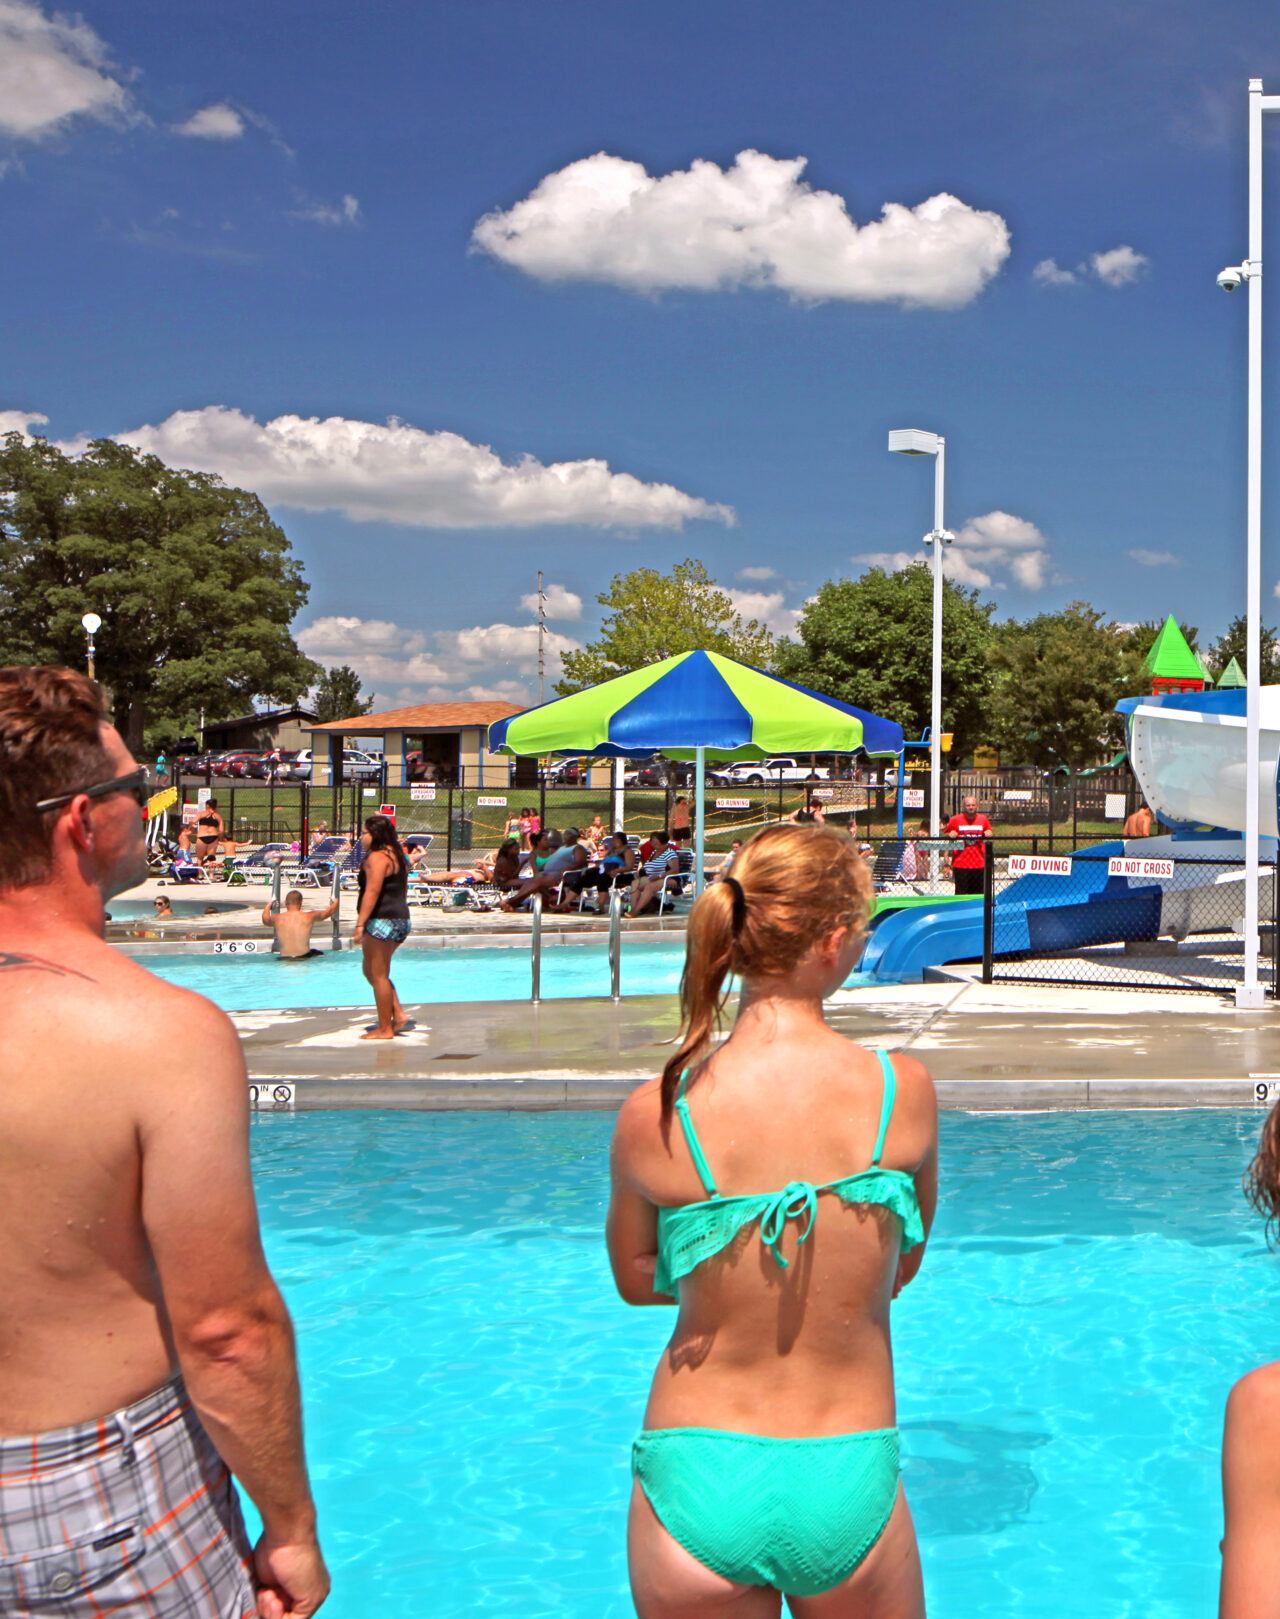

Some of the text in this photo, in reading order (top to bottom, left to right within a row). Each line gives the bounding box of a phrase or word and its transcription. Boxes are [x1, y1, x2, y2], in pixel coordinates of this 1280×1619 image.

[1011, 858, 1069, 872] NO DIVING
[1110, 860, 1172, 875] DO NOT CROSS
[215, 942, 223, 953] 3
[229, 942, 237, 953] 6
[1256, 1083, 1268, 1101] 9
